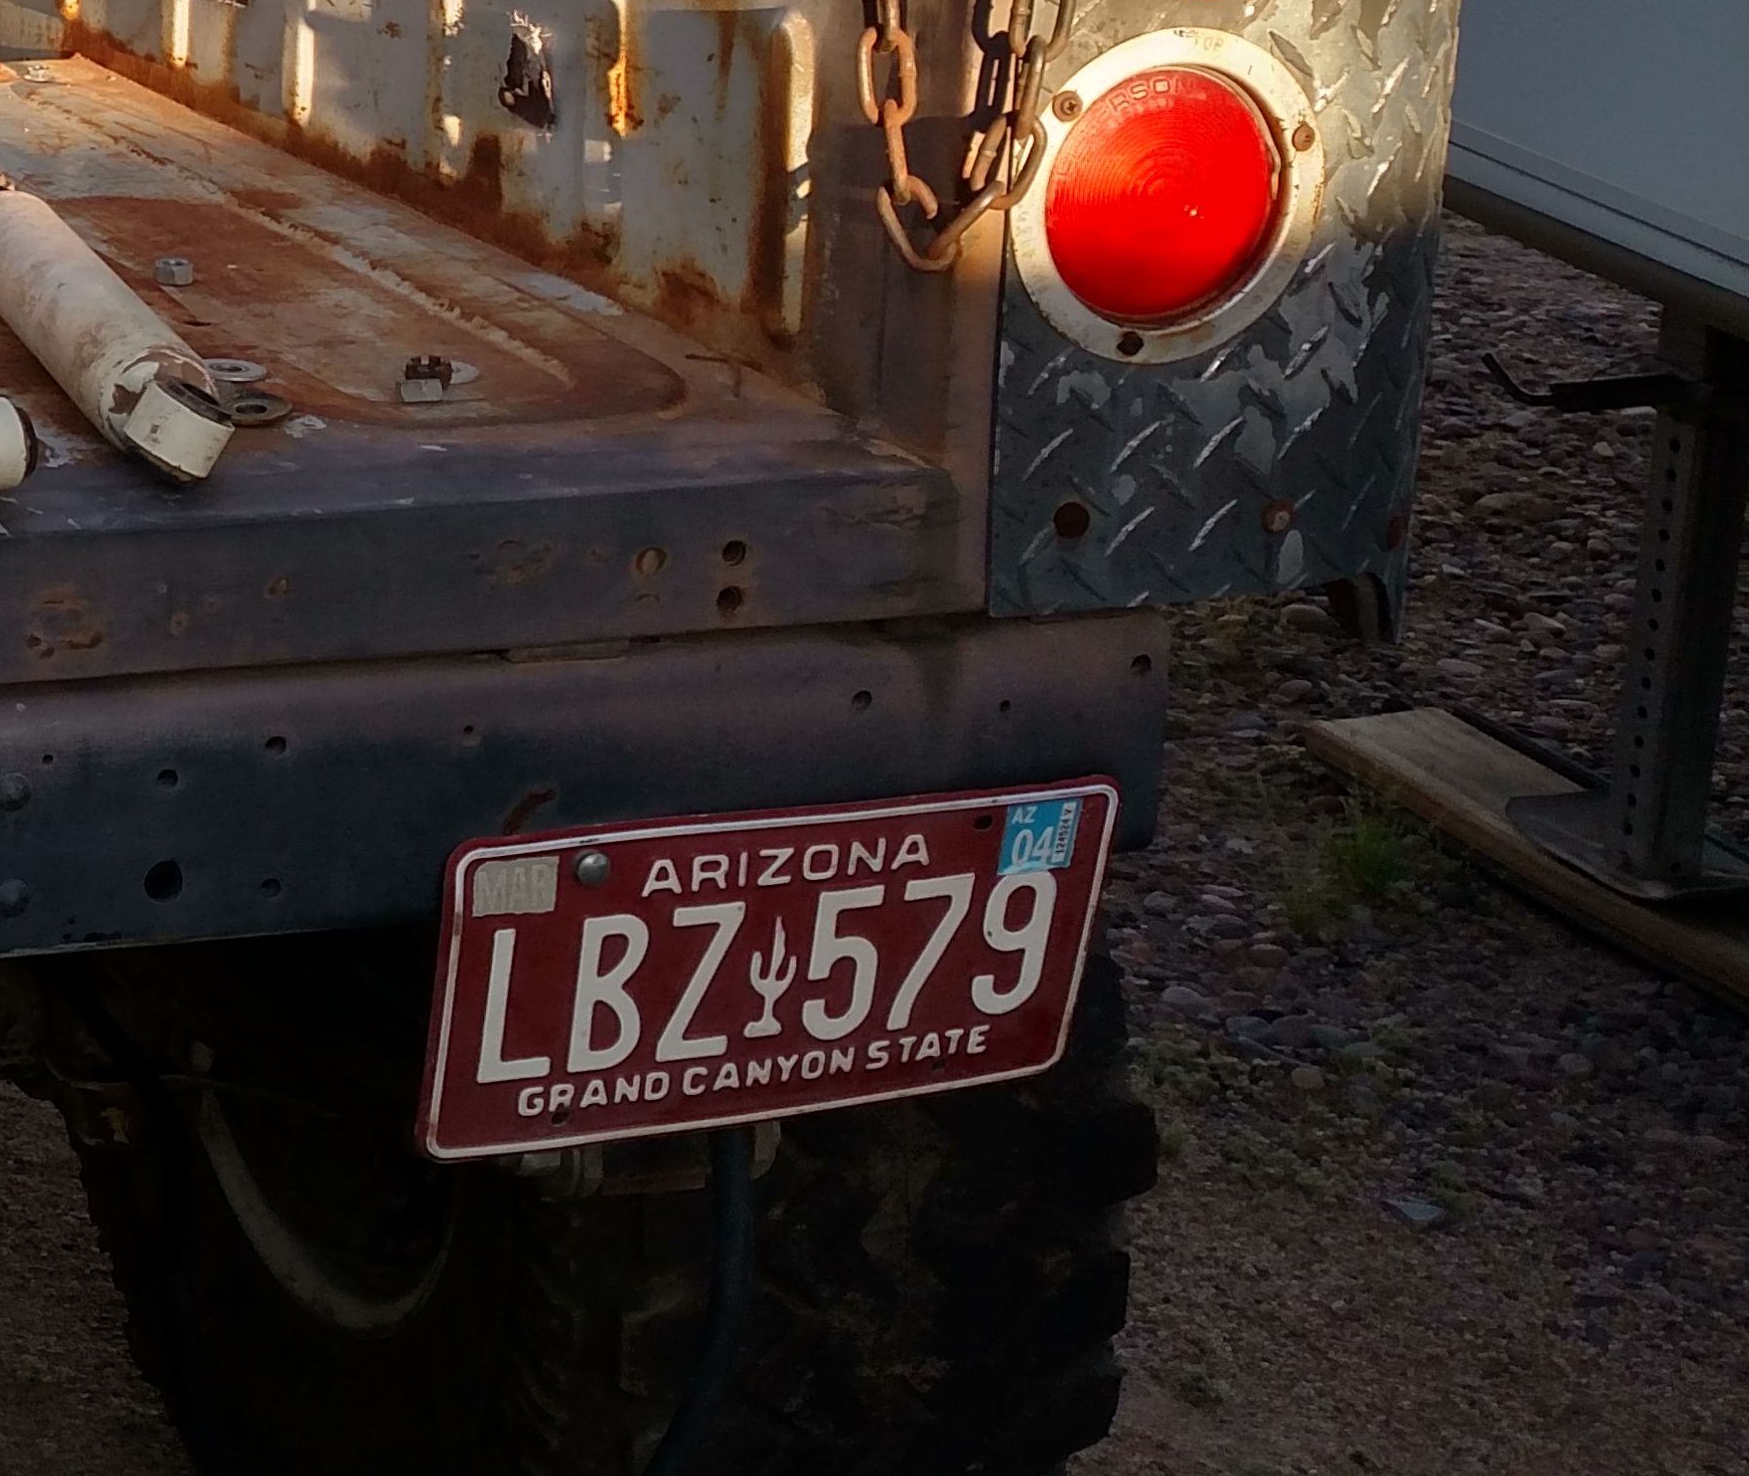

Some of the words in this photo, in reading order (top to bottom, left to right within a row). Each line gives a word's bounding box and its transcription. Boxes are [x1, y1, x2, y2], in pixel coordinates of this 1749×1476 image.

[1011, 805, 1039, 825] AZ
[641, 833, 931, 897] ARIZONA
[1011, 826, 1054, 868] 04
[476, 862, 551, 914] MAR
[476, 900, 747, 1084] LBZ
[799, 869, 1059, 1041] 579
[517, 1071, 668, 1117] GRAND
[682, 1046, 854, 1097] CANYON
[865, 1024, 991, 1069] STATE
